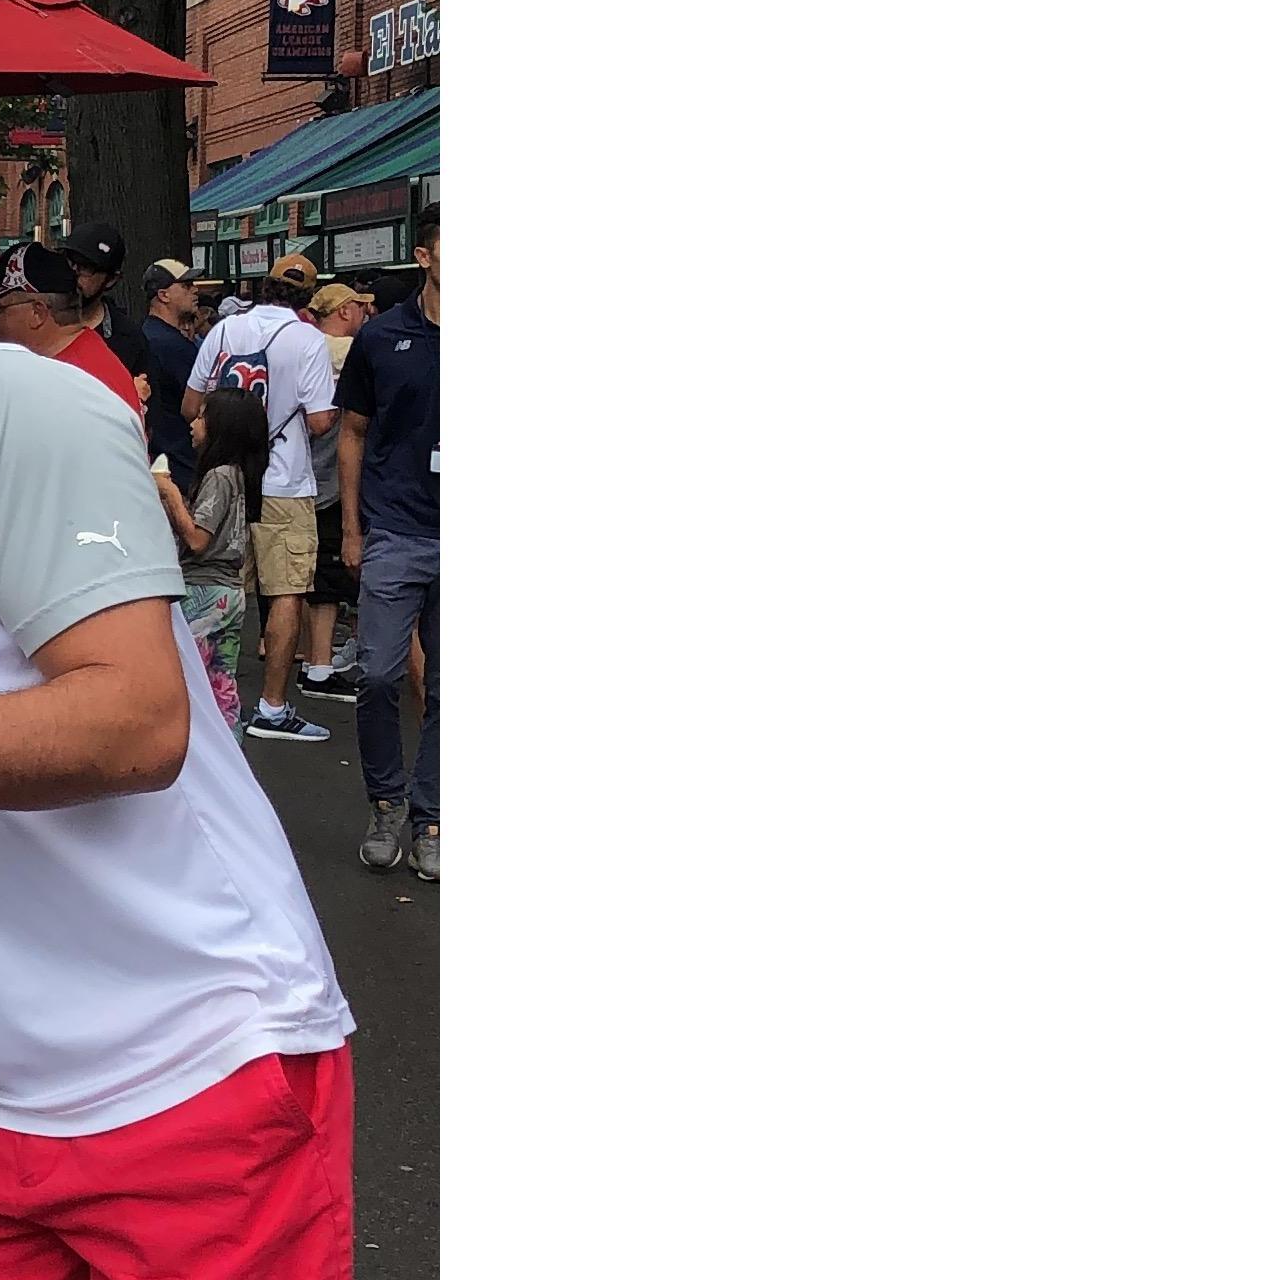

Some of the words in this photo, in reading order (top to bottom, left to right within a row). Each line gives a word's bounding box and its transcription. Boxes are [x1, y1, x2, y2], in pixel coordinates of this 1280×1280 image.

[275, 23, 330, 34] AMERICAN
[368, 8, 396, 77] El
[271, 46, 332, 58] CHAMPIONS
